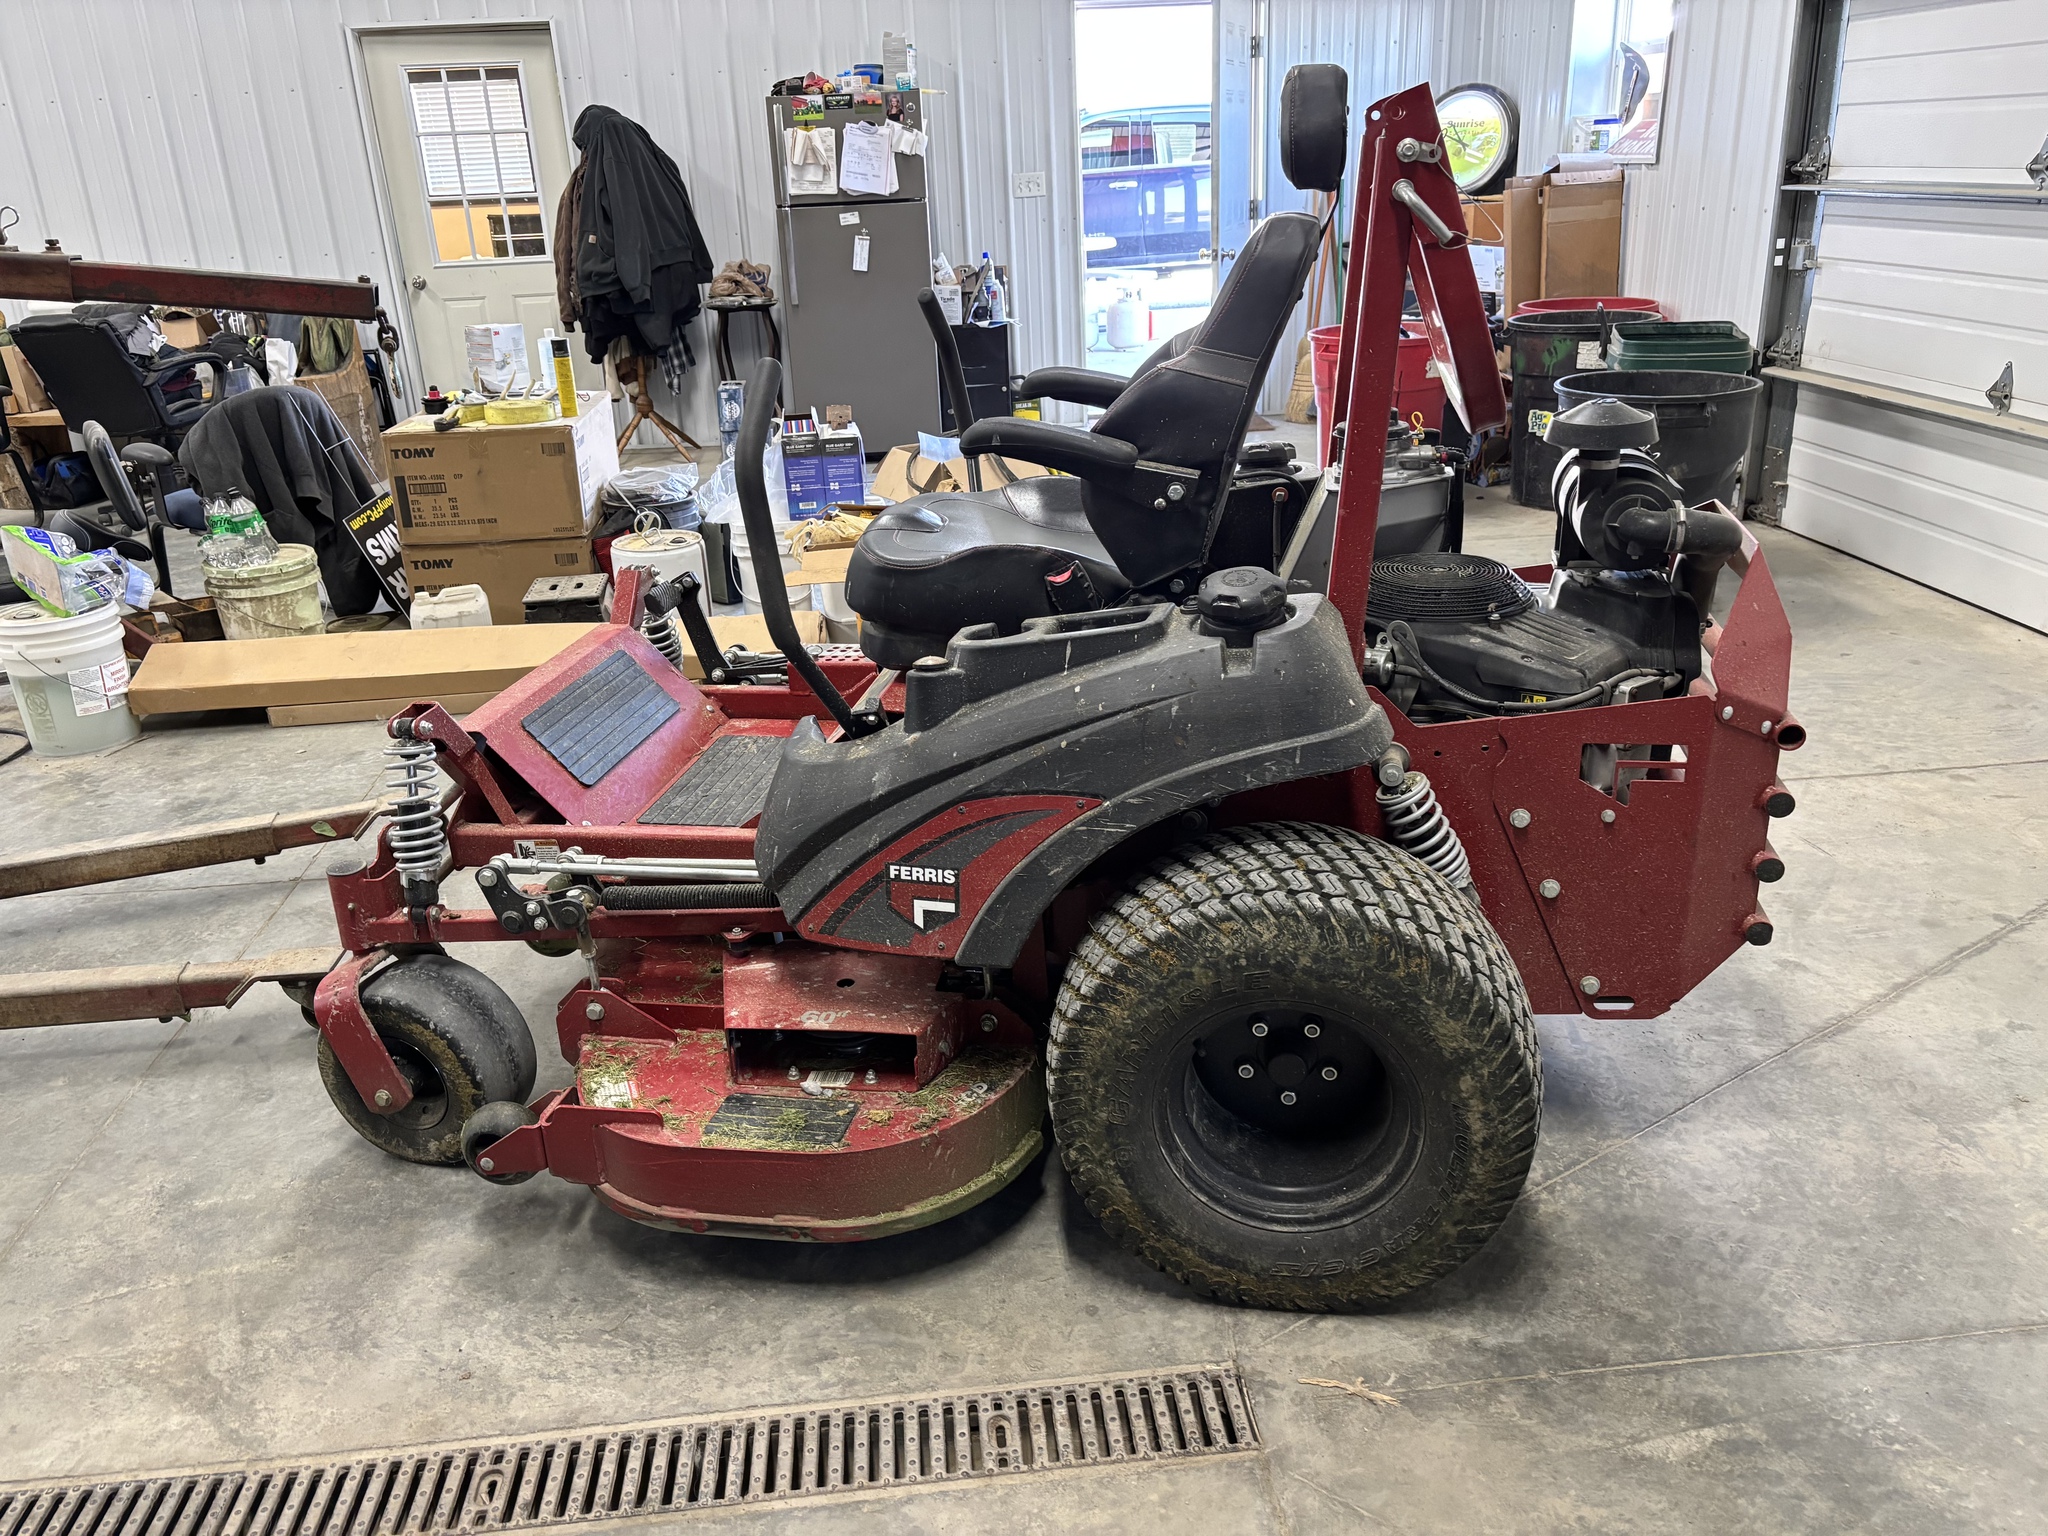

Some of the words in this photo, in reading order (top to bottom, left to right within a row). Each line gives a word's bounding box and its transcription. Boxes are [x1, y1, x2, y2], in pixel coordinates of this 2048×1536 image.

[1531, 422, 1547, 430] Pro
[390, 448, 436, 459] TOMY
[210, 517, 232, 529] prite
[410, 559, 454, 570] TOMY
[889, 865, 956, 884] FERRIS
[1360, 1204, 1441, 1268] TRAC
